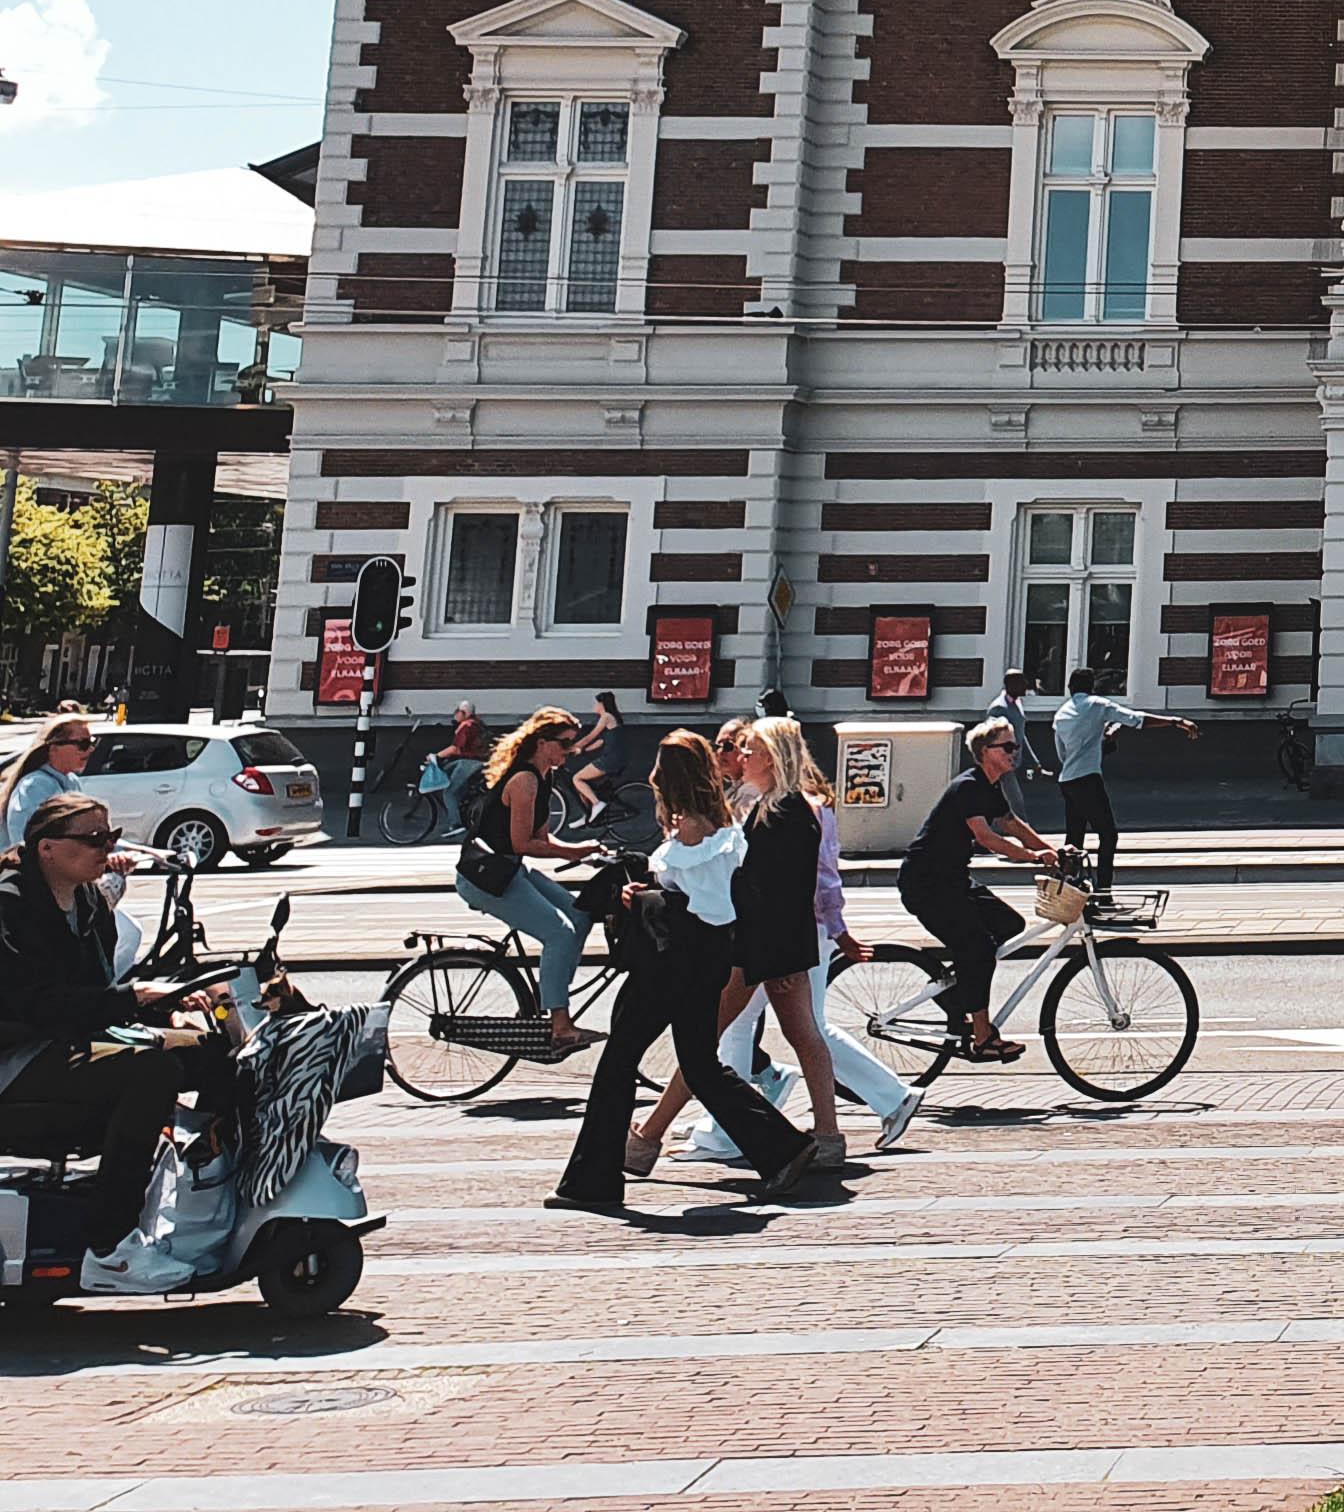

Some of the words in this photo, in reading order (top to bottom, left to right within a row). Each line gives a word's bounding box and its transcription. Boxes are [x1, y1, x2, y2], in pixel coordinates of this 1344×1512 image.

[1241, 638, 1266, 646] GOED
[336, 656, 365, 664] VOOR
[1221, 663, 1257, 671] ELKAAR
[330, 669, 362, 678] ELKAA
